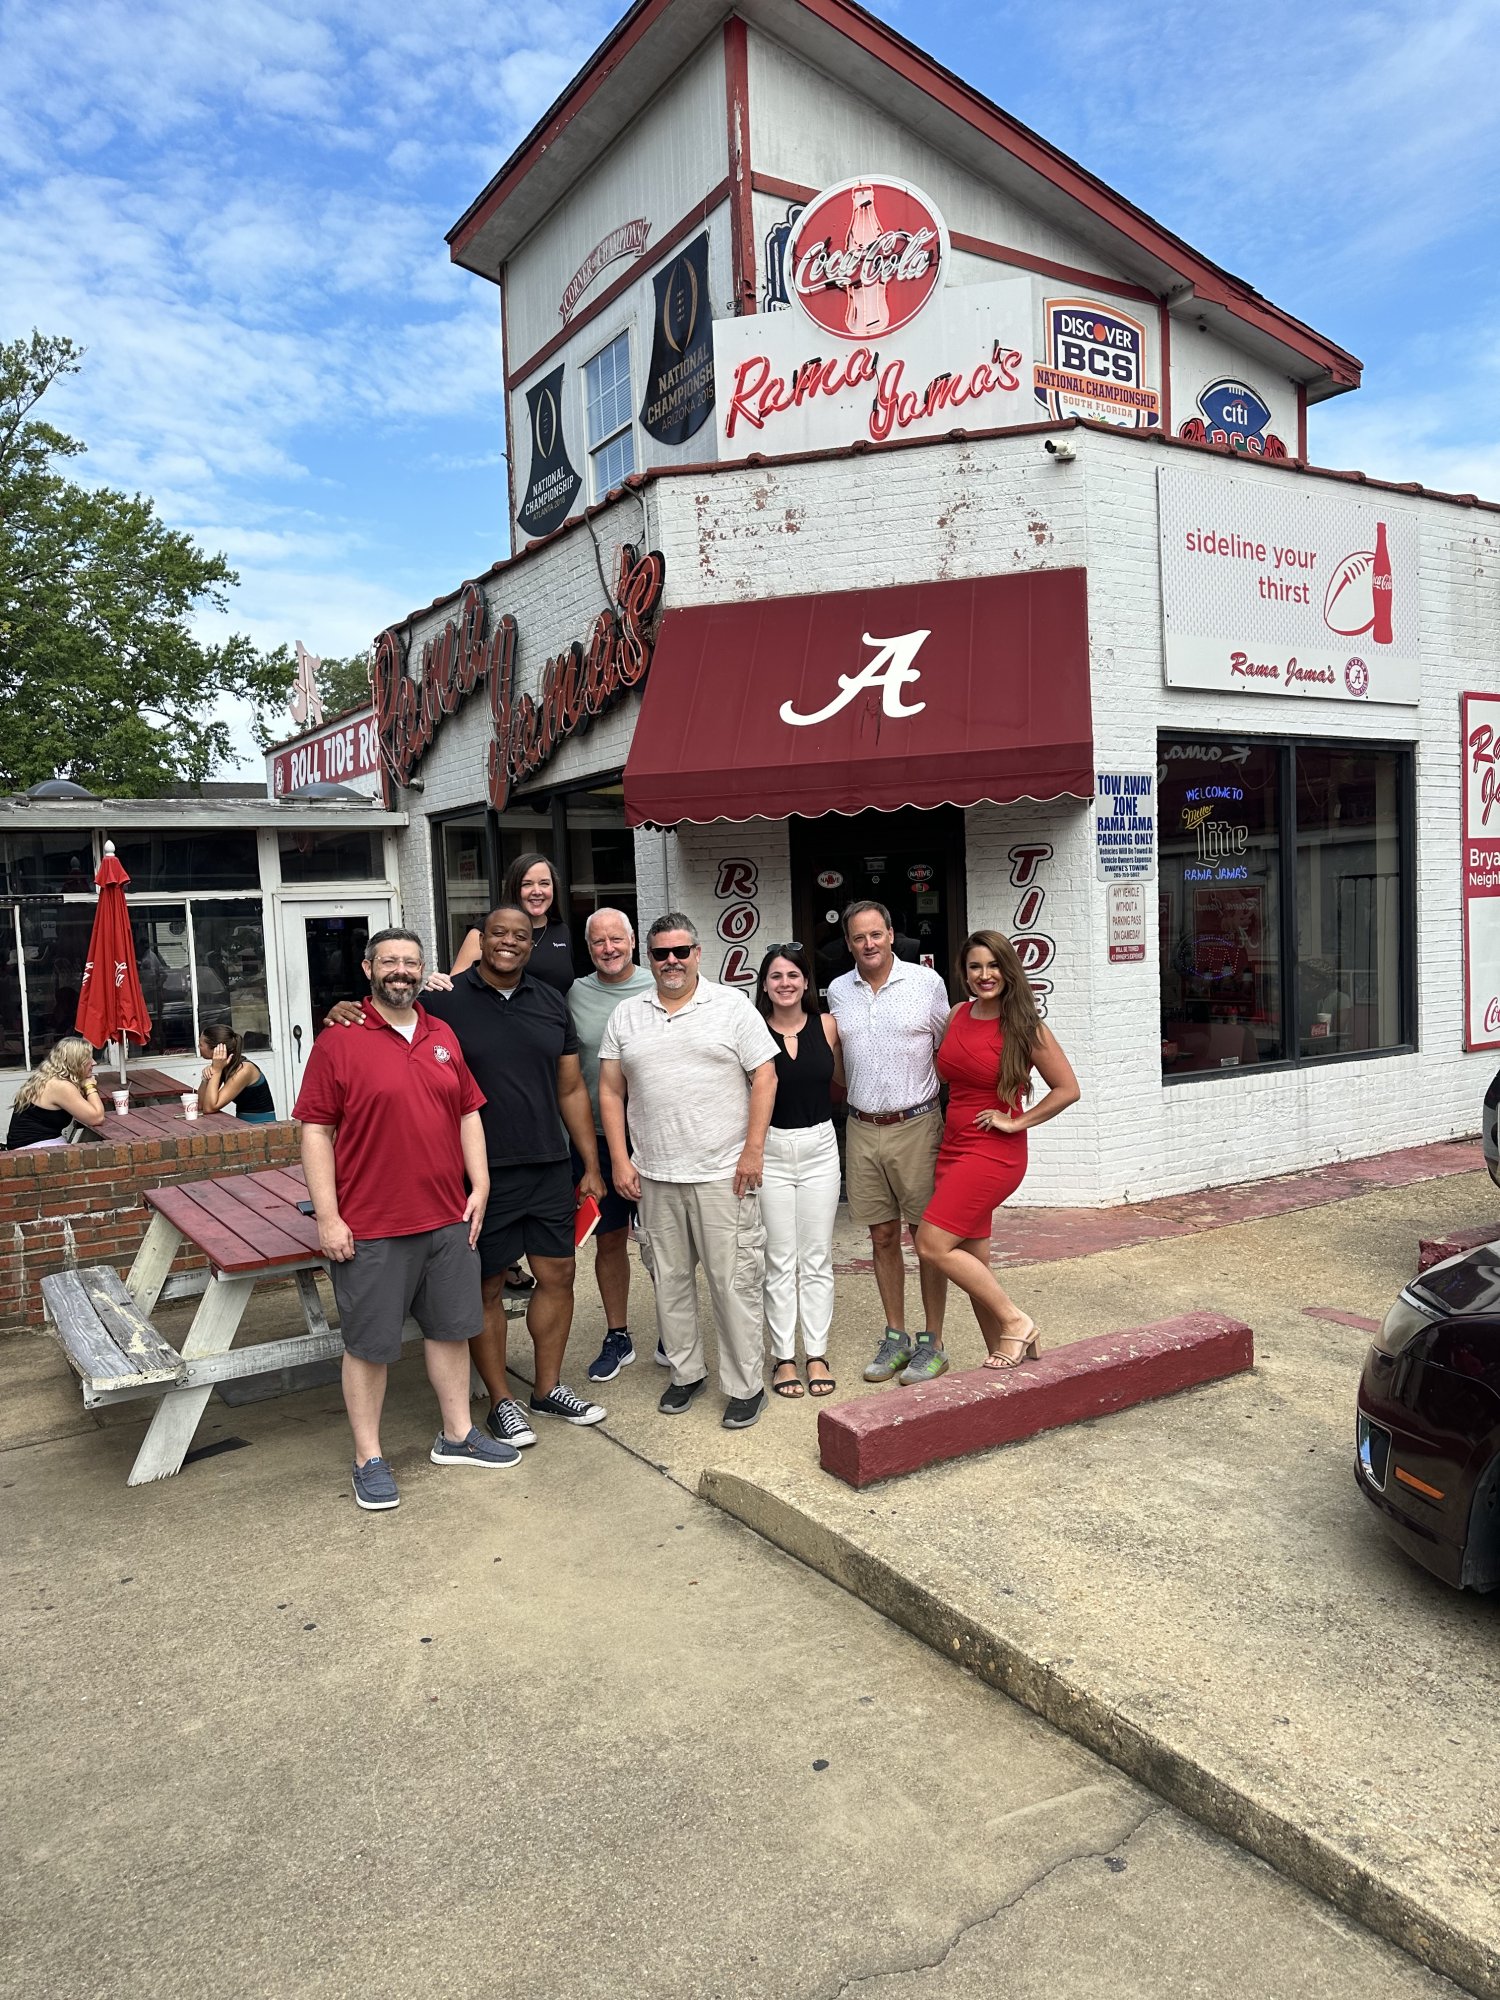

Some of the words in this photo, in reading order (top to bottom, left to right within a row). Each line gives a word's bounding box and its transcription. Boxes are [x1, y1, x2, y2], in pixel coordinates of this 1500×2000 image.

[564, 260, 592, 310] CORNER
[597, 222, 642, 266] CHAMPIONS
[1061, 314, 1132, 349] DISCOVER
[658, 342, 709, 395] NATIONAL
[1062, 340, 1132, 382] BCS
[647, 360, 714, 425] CHAMPIONSH
[726, 347, 876, 438] Rama
[868, 345, 1023, 441] Jama's
[1037, 369, 1085, 393] NATIONAL
[1086, 381, 1156, 409] CHAMPIONSHIP
[661, 399, 695, 432] ARIZONA
[697, 384, 714, 407] 2015
[1063, 395, 1093, 410] SOUTH
[1096, 402, 1133, 418] FLORIDA
[1222, 404, 1248, 425] citi
[525, 475, 574, 516] CHAMPIONSHIP
[532, 466, 566, 497] NATIONAL
[532, 505, 554, 522] ATLANTA
[1186, 528, 1267, 562] sideline
[1273, 546, 1317, 570] your
[1258, 576, 1310, 605] thirst
[779, 629, 932, 726] A
[1230, 651, 1280, 679] Rama
[1285, 657, 1336, 688] Jama's
[367, 583, 494, 812] Rama
[290, 743, 321, 791] ROLL
[323, 727, 354, 779] TIDE
[1098, 775, 1121, 796] TOW
[1123, 776, 1152, 796] AWAY
[1186, 786, 1231, 802] WELCOME
[1232, 787, 1244, 800] TO
[1113, 796, 1138, 816] ZONE
[1182, 804, 1214, 826] Miller
[1098, 817, 1126, 831] RAMA
[1127, 817, 1153, 831] JAMA
[1098, 834, 1132, 846] PARKING
[1134, 833, 1153, 845] ONLY
[1196, 820, 1248, 864] Lite
[1129, 864, 1148, 872] TOWING
[1184, 869, 1213, 881] RAMA
[1215, 865, 1249, 880] JAMA'S
[1113, 888, 1122, 897] ANY
[1122, 887, 1140, 897] VEHICLE
[1116, 902, 1134, 911] WITHOUT
[716, 858, 760, 998] ROL
[1113, 916, 1130, 926] PARKING
[1131, 916, 1141, 925] PASS
[1114, 930, 1120, 940] ON
[1121, 929, 1140, 940] GAMEDAY
